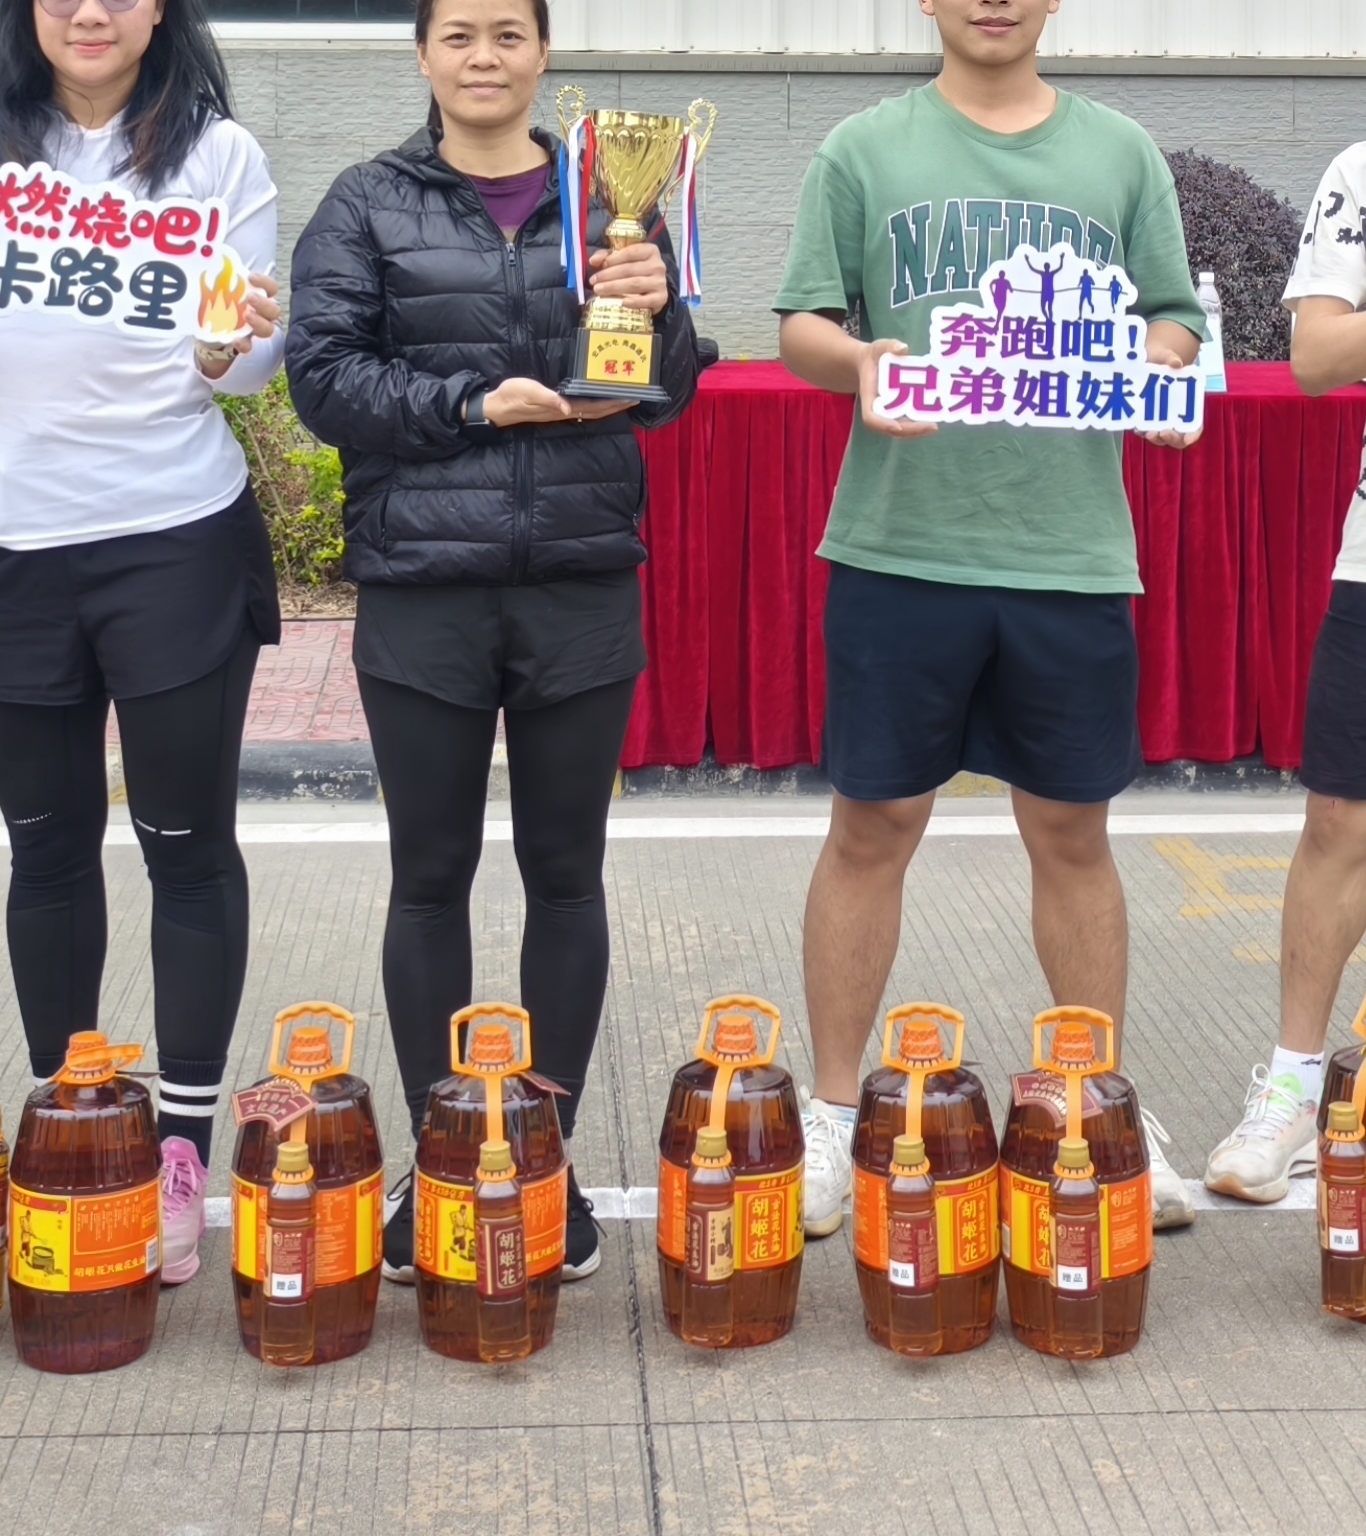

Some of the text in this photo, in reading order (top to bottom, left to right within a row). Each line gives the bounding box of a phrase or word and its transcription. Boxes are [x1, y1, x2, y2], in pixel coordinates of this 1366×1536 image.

[939, 313, 1140, 363] 奔跑吧！
[604, 359, 636, 376] 冠军
[883, 364, 1198, 425] 兄弟姐妹们
[751, 1198, 769, 1259] 胡姬花
[771, 1198, 780, 1252] 古法花生油
[961, 1200, 978, 1262] 胡姬花
[500, 1232, 516, 1285] 胡姬花
